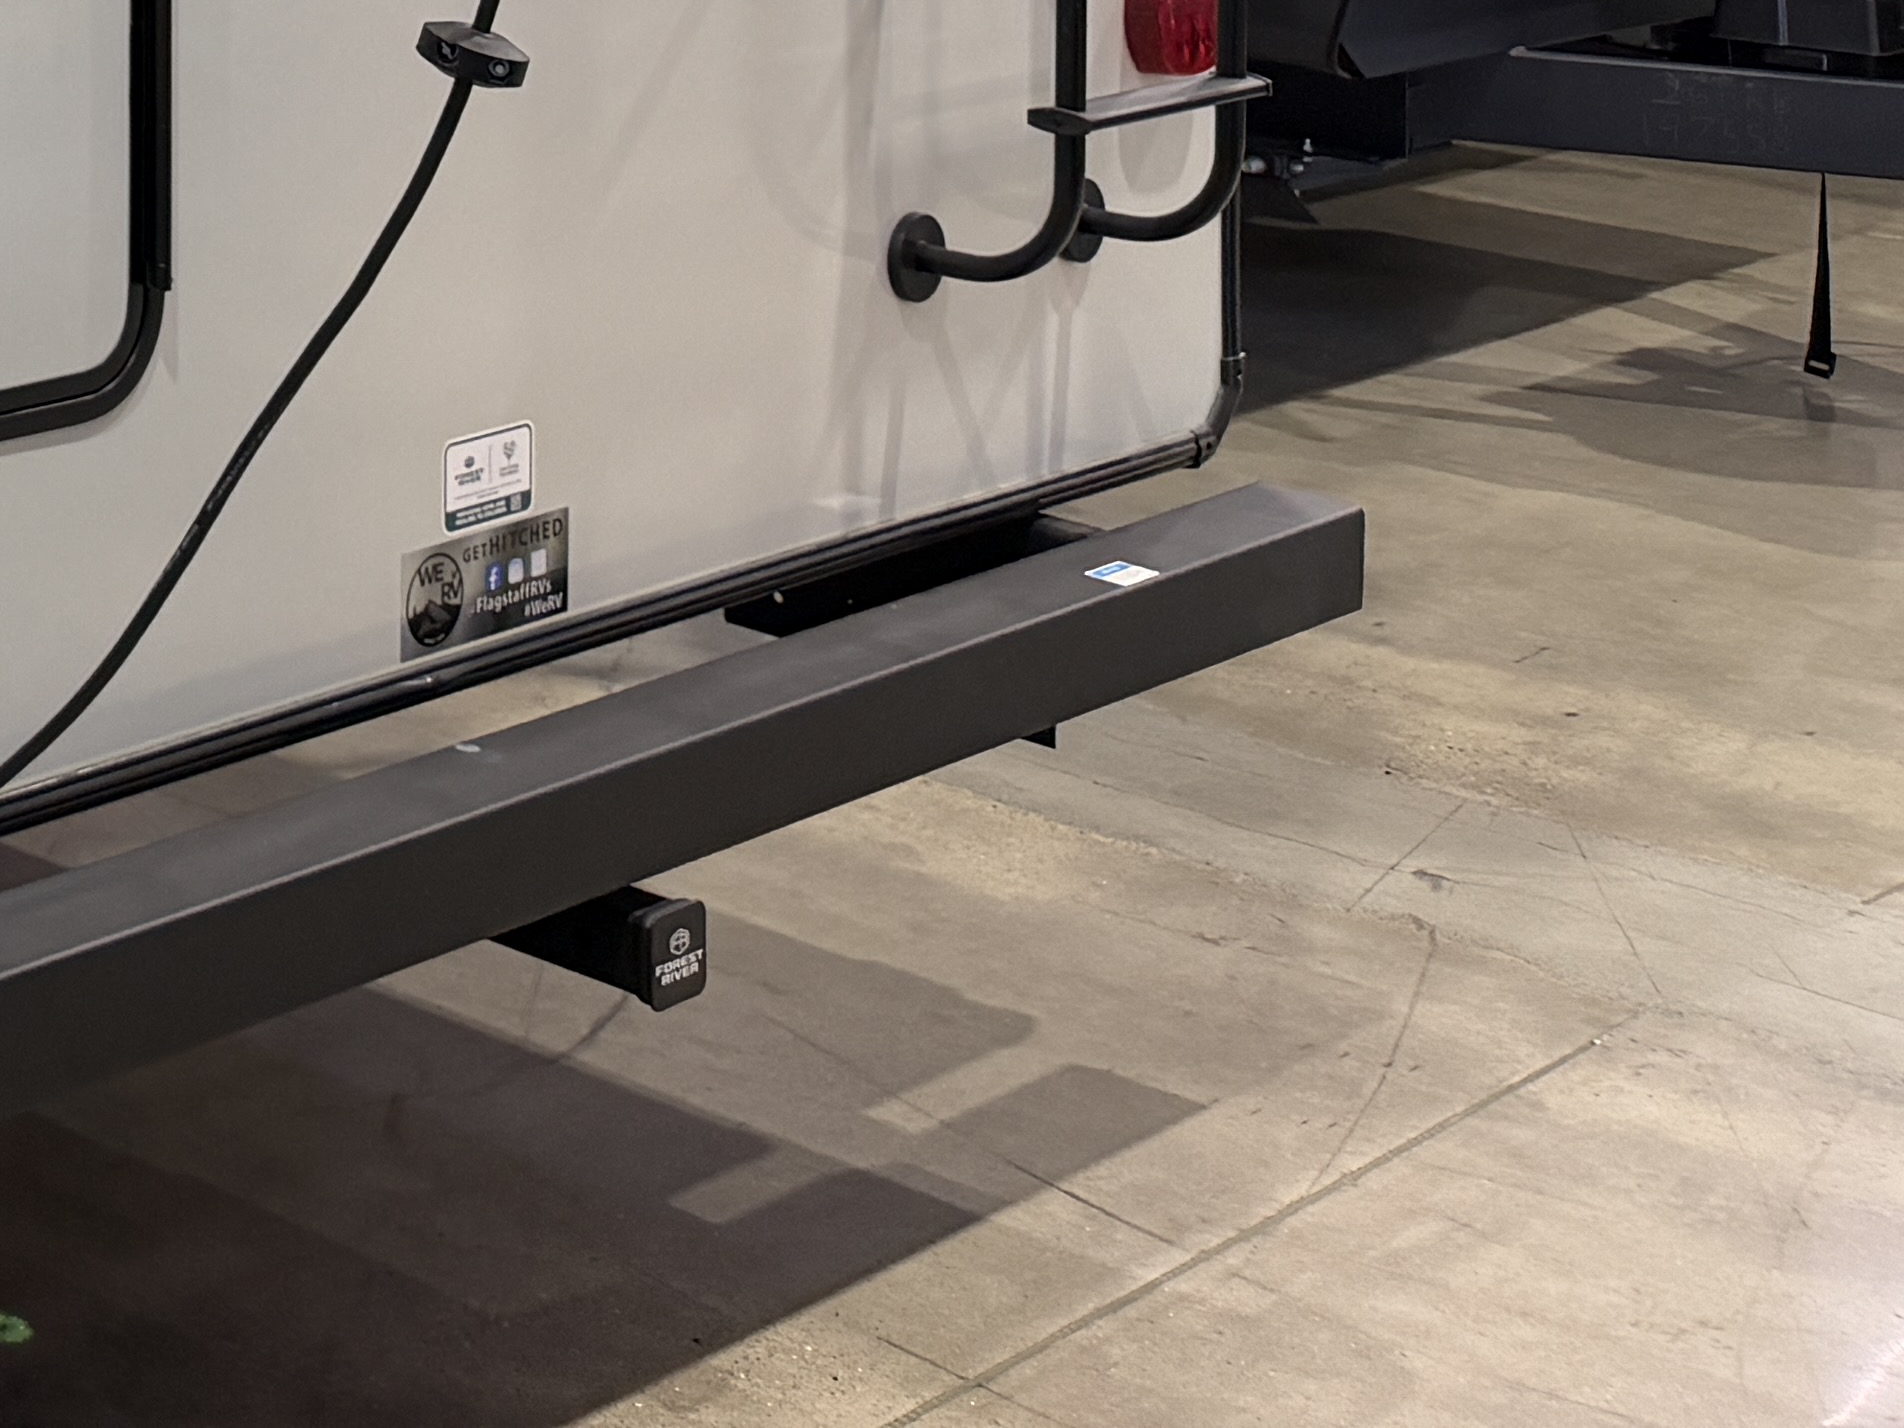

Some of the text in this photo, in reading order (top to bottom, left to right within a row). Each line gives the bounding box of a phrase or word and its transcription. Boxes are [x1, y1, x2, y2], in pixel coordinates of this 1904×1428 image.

[417, 561, 445, 587] WE
[475, 578, 552, 614] FlagstaffRVs
[655, 948, 704, 978] FOREST
[661, 961, 700, 987] RIVER
